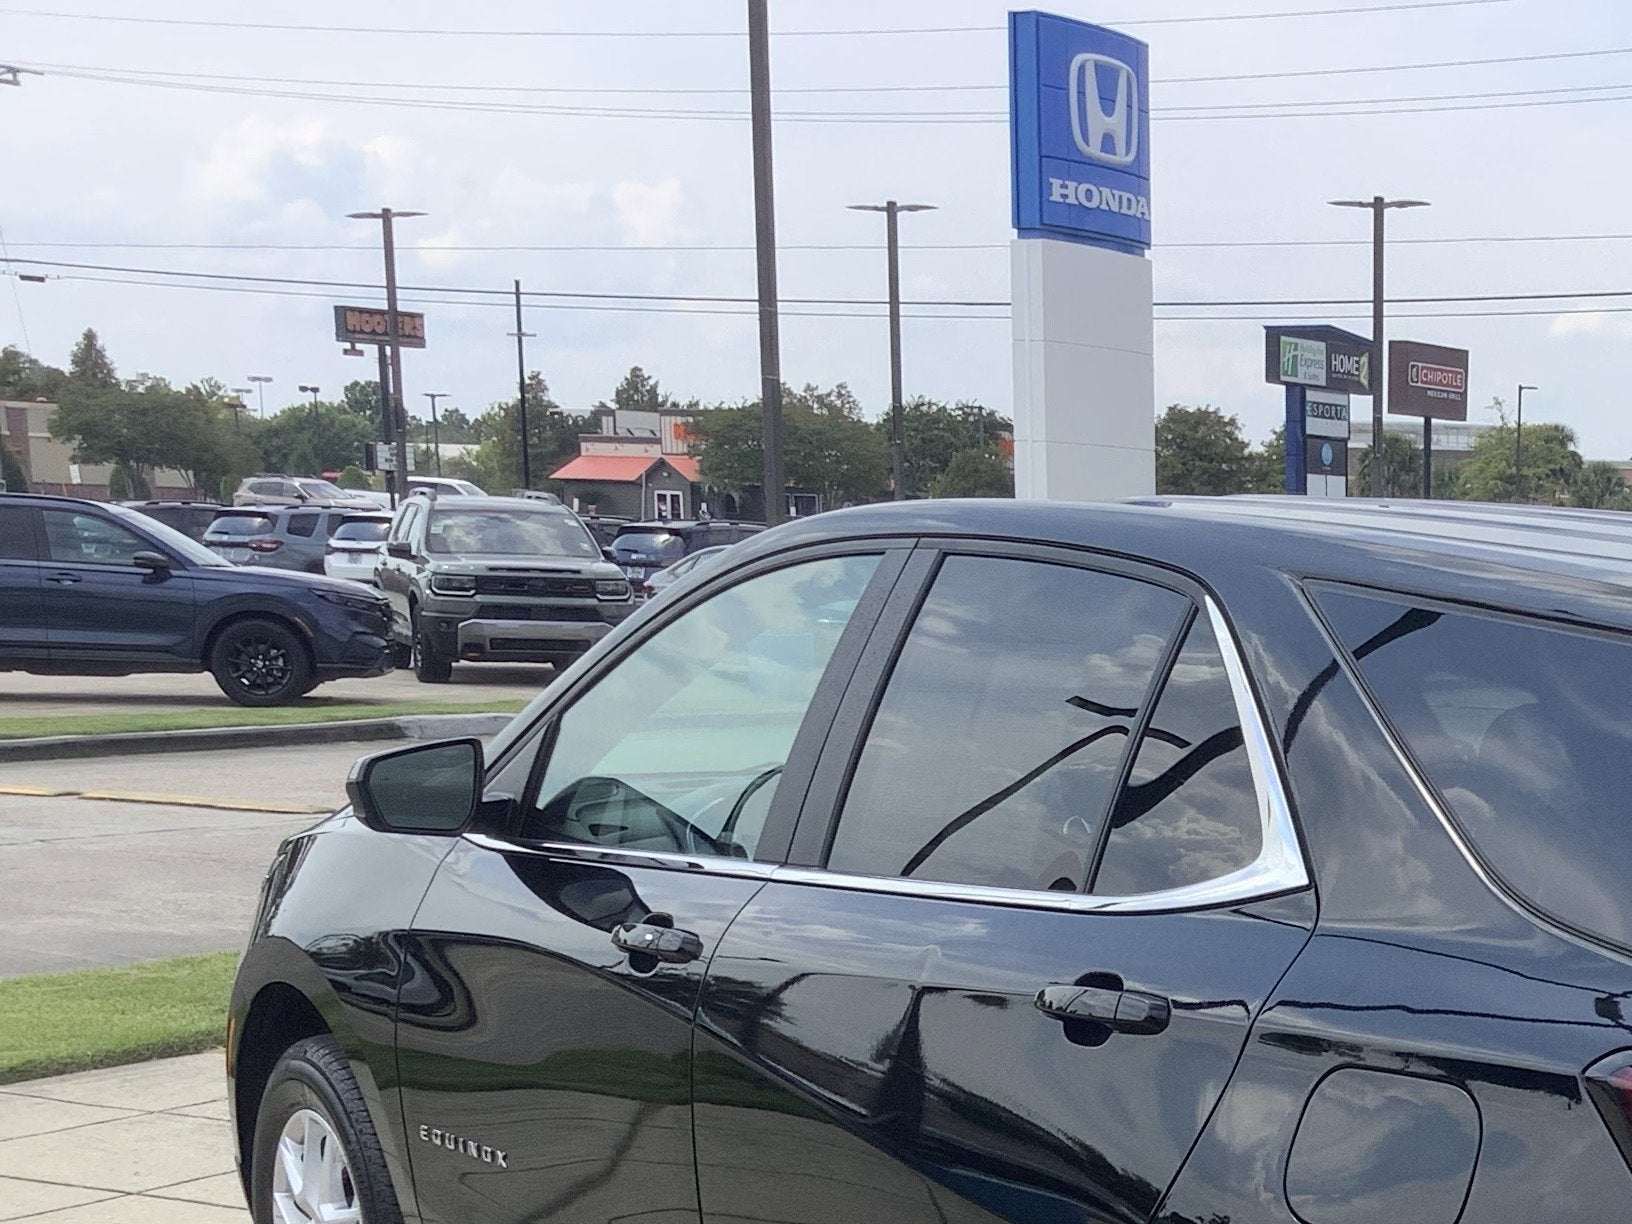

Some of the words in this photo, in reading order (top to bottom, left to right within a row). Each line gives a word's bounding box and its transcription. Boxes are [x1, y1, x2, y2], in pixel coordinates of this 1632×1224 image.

[1049, 178, 1151, 221] HONDA
[1421, 369, 1462, 386] CHIPOTLE
[420, 1124, 508, 1168] EQUINOX
